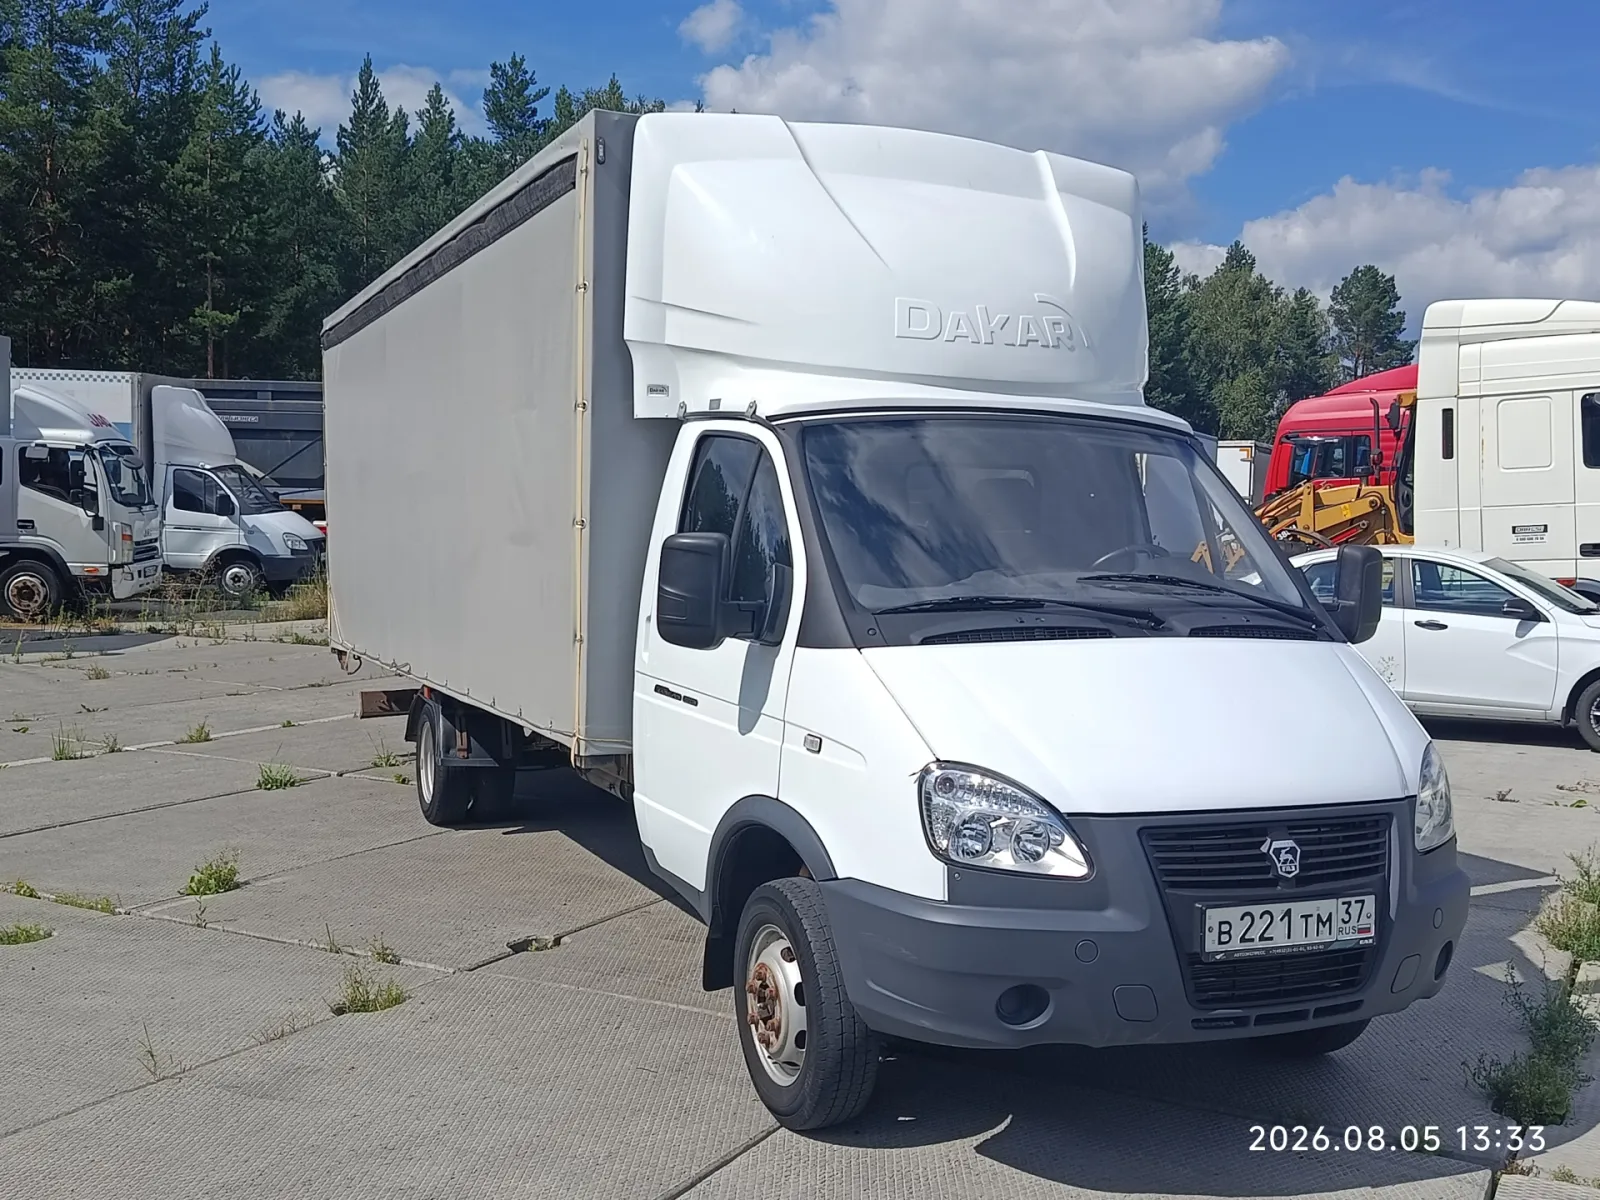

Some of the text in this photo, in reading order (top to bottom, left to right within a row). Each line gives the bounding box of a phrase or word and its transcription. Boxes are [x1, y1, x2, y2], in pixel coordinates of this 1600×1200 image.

[895, 297, 1075, 351] DAKAR
[1341, 899, 1366, 924] 37
[1338, 926, 1357, 936] RUS
